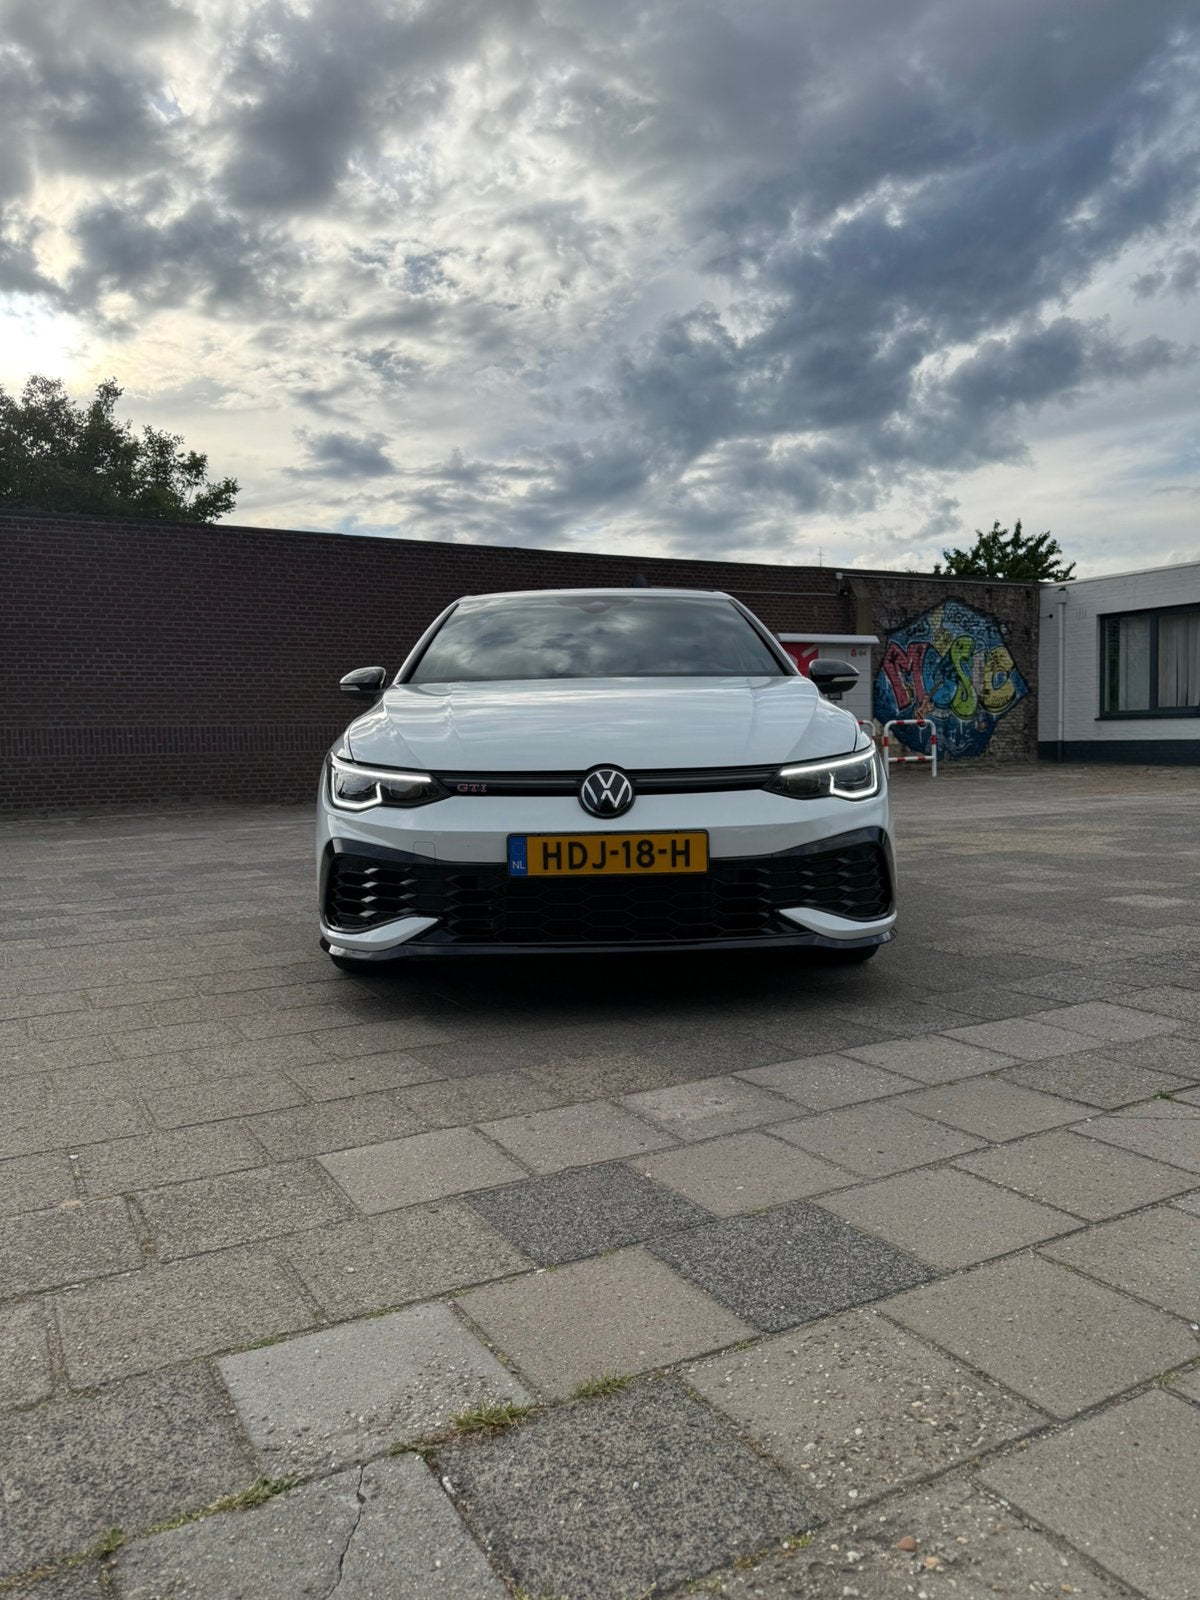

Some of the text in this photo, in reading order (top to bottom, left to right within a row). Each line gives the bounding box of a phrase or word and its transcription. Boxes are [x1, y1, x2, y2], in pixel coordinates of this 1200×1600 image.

[457, 783, 487, 793] GTI
[583, 770, 631, 812] VW
[542, 839, 691, 870] HDJ-18-H
[511, 860, 526, 870] NL
